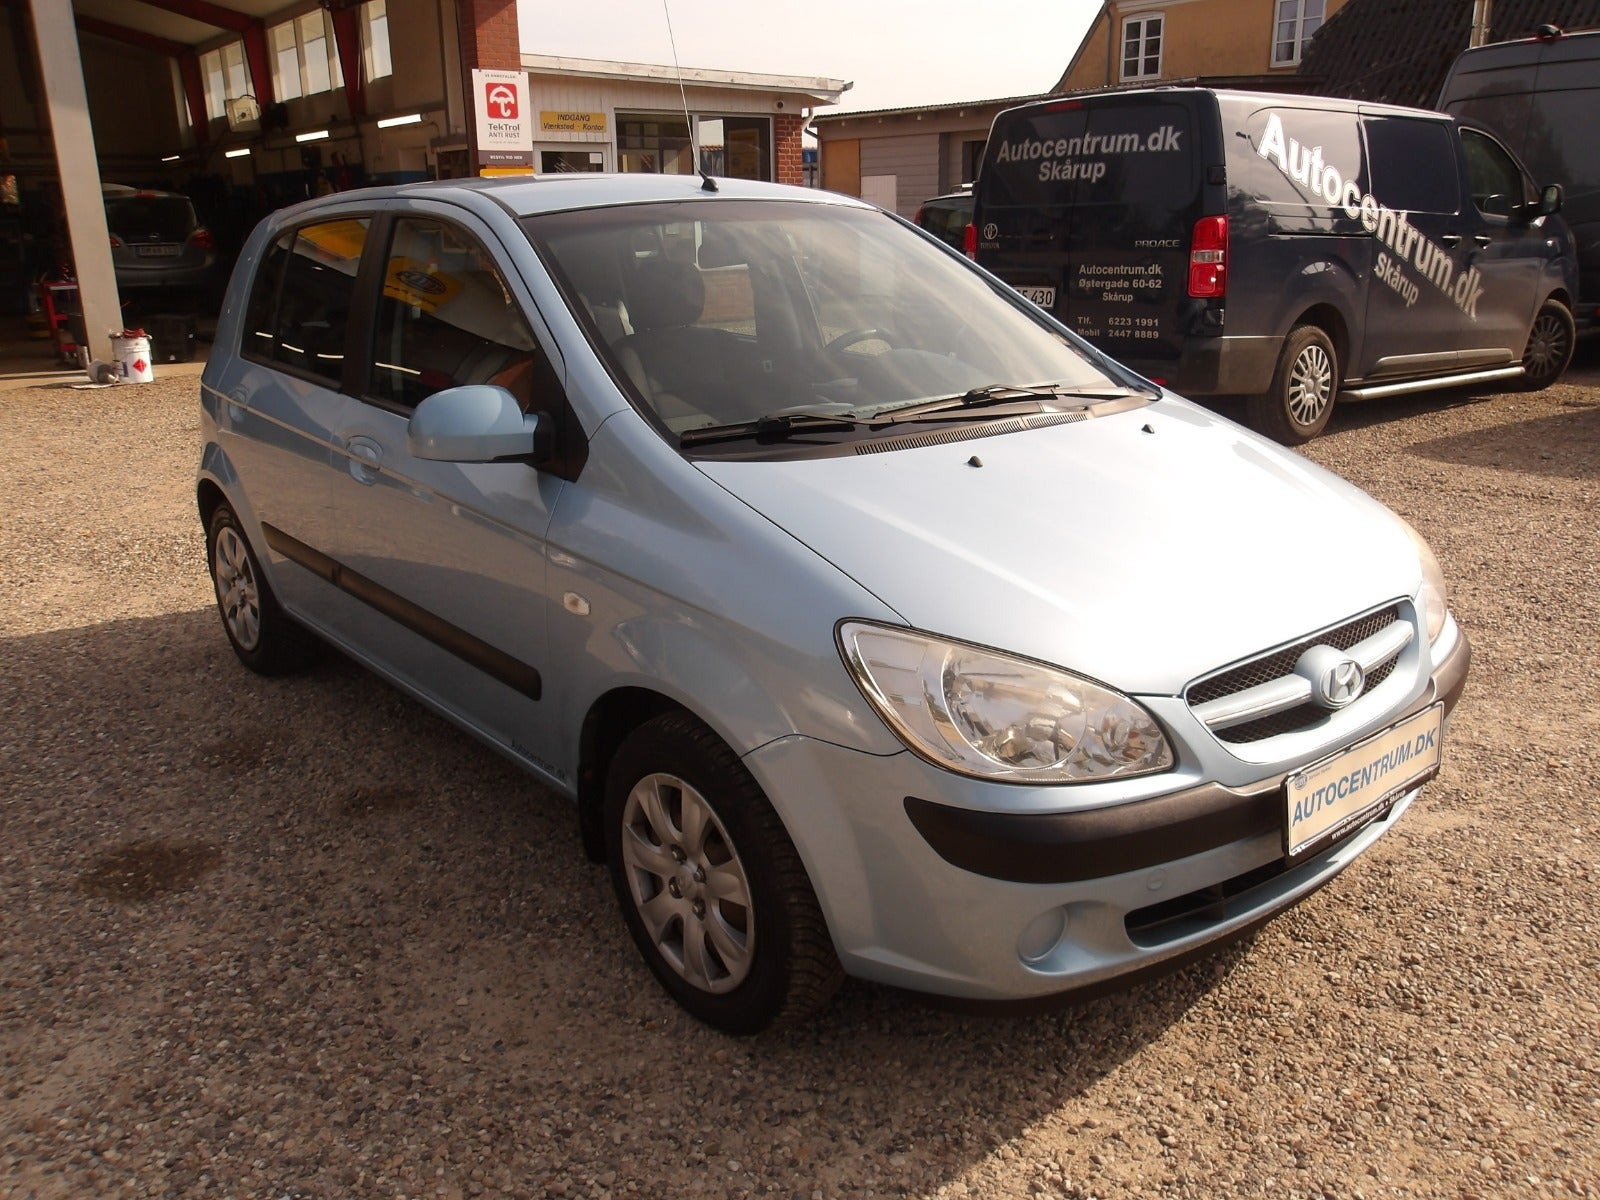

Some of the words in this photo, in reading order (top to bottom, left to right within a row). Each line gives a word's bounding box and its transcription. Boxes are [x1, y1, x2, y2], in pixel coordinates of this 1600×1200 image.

[557, 113, 591, 122] INDGANG
[487, 123, 520, 131] TekTrol
[543, 122, 575, 130] Værksted
[582, 123, 604, 131] Kontor
[996, 126, 1185, 164] Autocentrum.dk
[1038, 158, 1107, 184] Skårup
[1257, 112, 1484, 322] Autocentrum.dk
[1134, 239, 1181, 248] PROACE
[1078, 264, 1163, 275] Autocentrum.dk
[1078, 278, 1130, 290] Østergade
[1132, 279, 1162, 289] 60-62
[1374, 251, 1420, 308] Skårup
[1102, 291, 1134, 303] Skårup
[1077, 316, 1092, 325] Tlf.
[1108, 317, 1132, 326] 6223
[1135, 318, 1159, 327] 1991
[1077, 328, 1100, 337] Mobil
[1108, 329, 1131, 337] 2447
[1134, 330, 1159, 339] 8889
[1292, 726, 1438, 827] AUTOCENTRUM.DK
